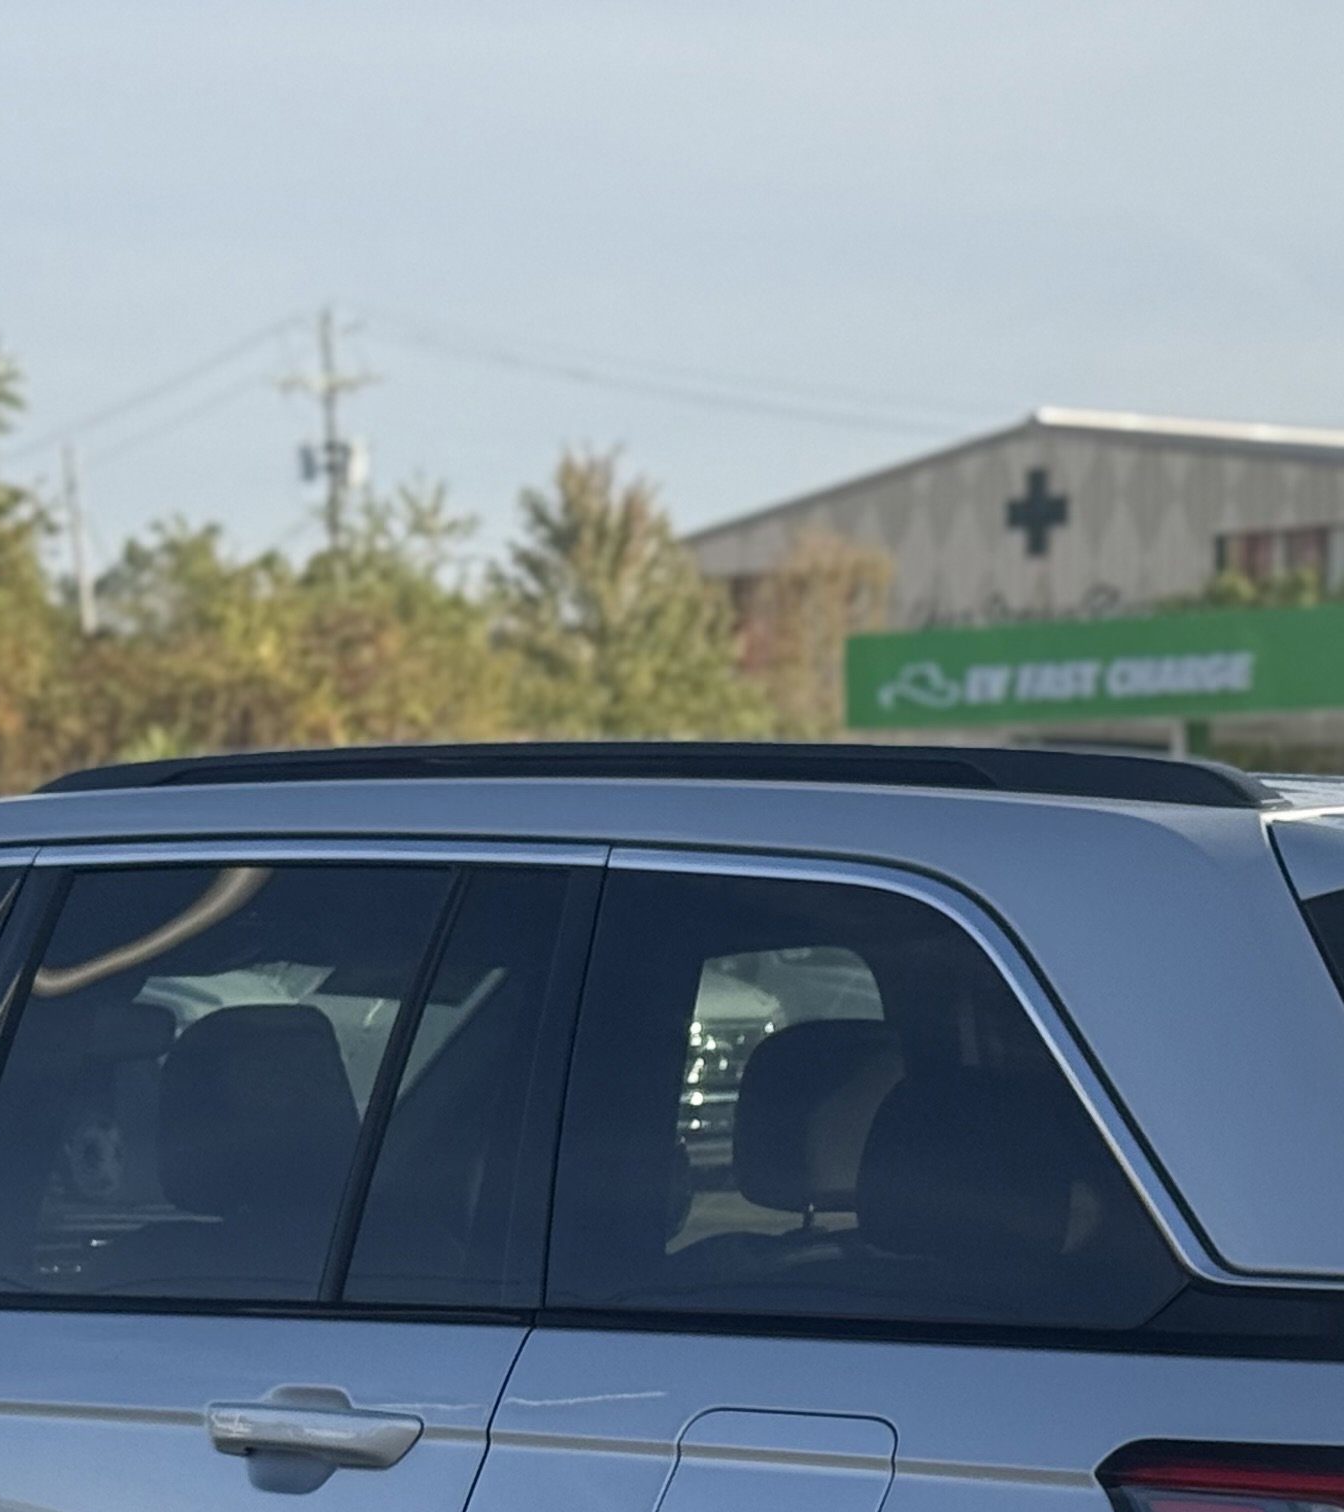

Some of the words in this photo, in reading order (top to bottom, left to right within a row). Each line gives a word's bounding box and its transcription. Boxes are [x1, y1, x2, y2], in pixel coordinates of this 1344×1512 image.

[964, 664, 1009, 699] EV
[1016, 660, 1102, 697] FAST
[1106, 653, 1253, 696] CHARGE
